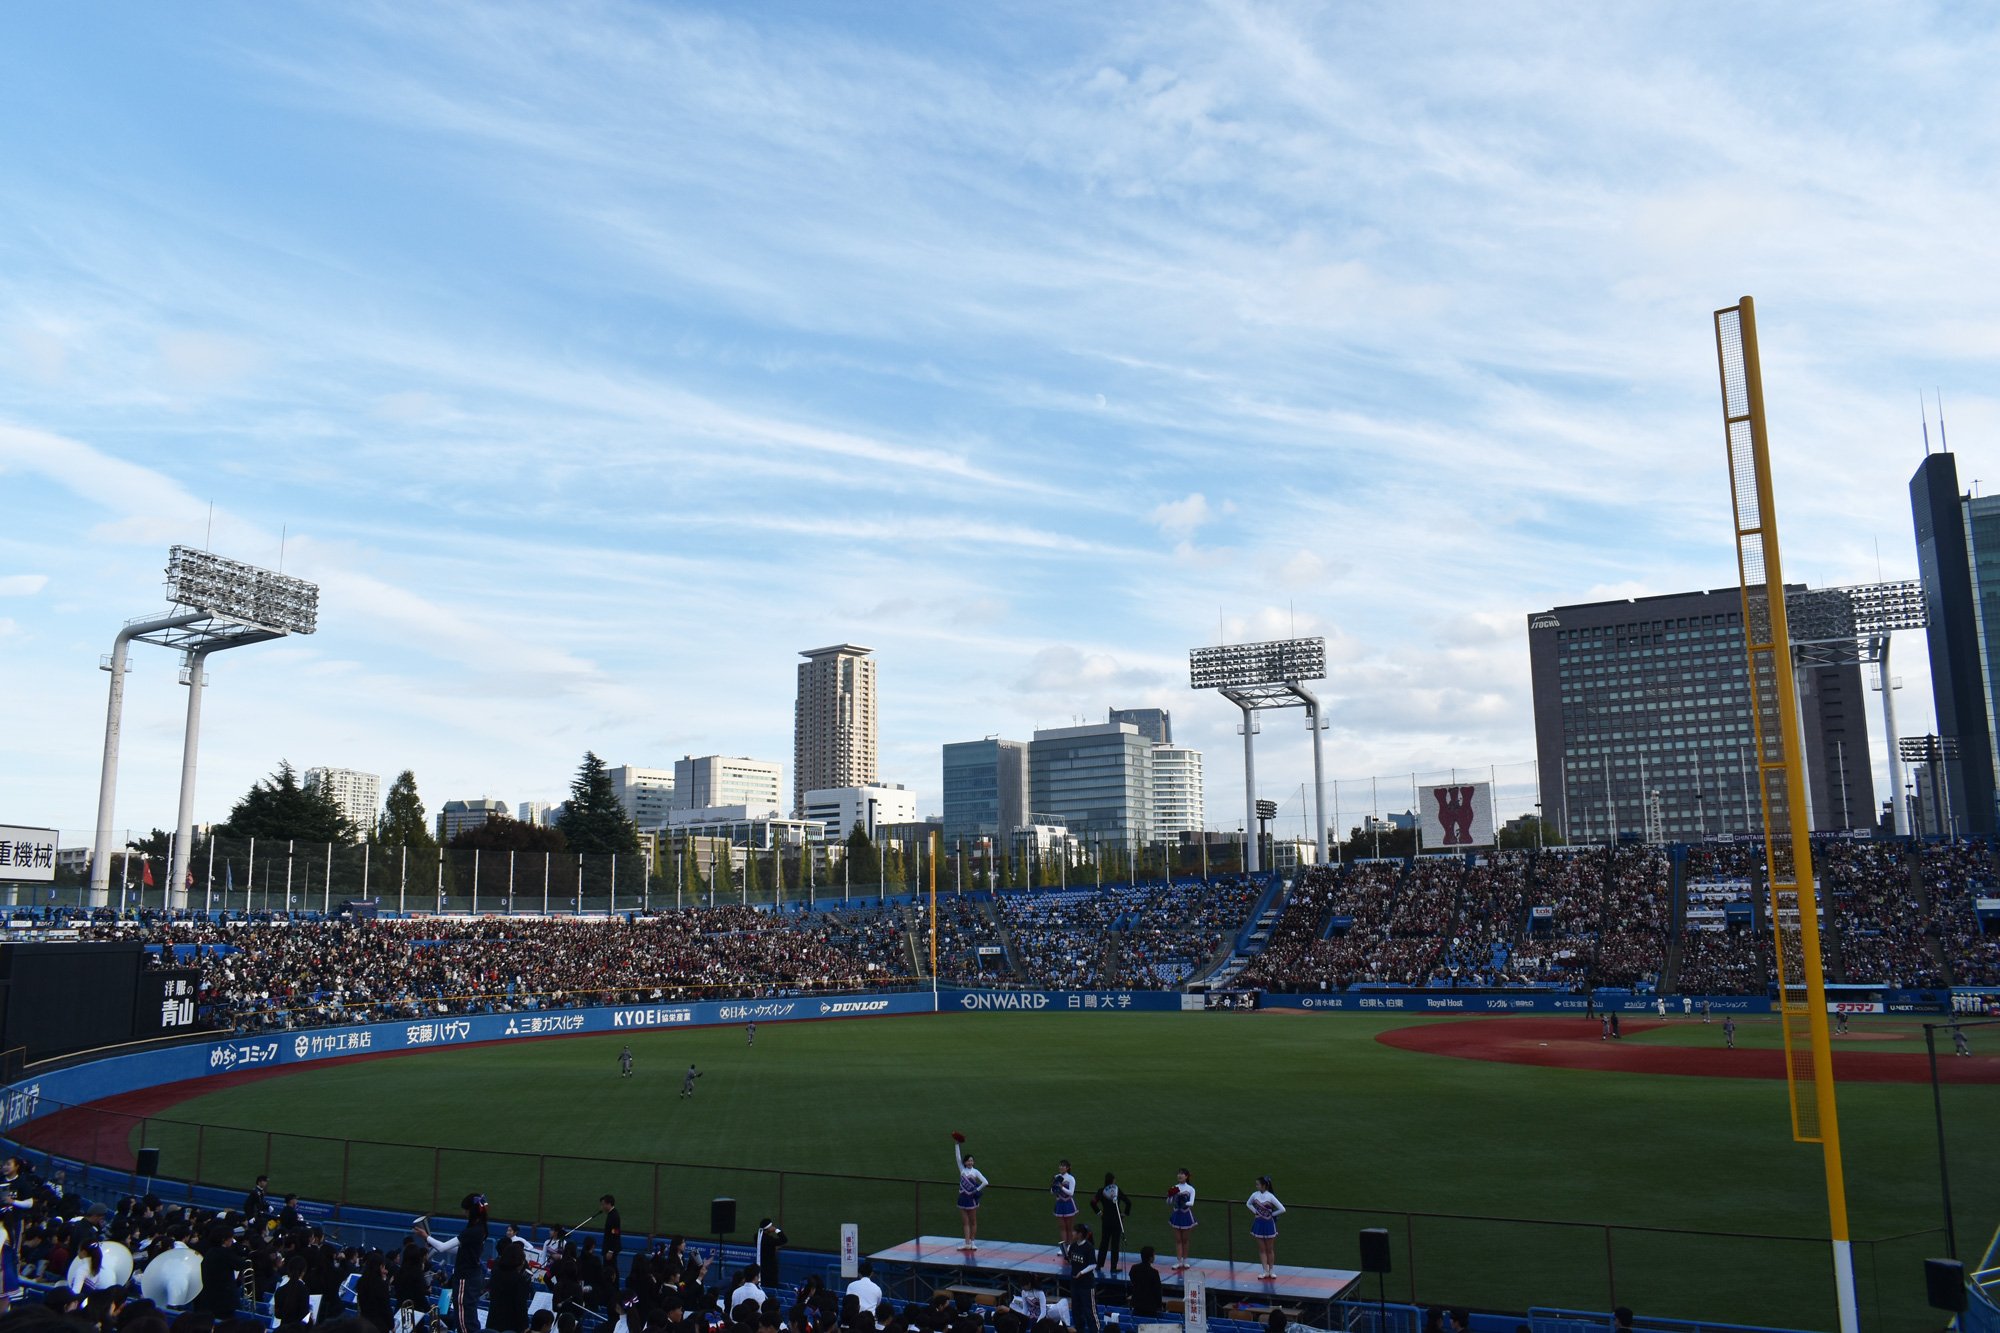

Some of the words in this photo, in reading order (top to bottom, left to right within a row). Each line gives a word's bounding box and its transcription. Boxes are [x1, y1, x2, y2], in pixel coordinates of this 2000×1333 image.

[1530, 620, 1560, 630] ITOCHU
[164, 980, 194, 997] 洋服の
[831, 1001, 888, 1012] DUNLOP
[960, 993, 1049, 1010] ONWARD
[1427, 998, 1446, 1008] Royal
[1447, 998, 1463, 1007] Host
[162, 998, 194, 1027] 青山
[614, 1009, 661, 1026] KYOEI
[730, 1003, 795, 1019] 日本ハウズイング
[406, 1020, 470, 1045] 安藤ハザマ
[520, 1015, 584, 1033] 三菱ガス化学
[311, 1031, 372, 1054] 竹中工務店
[210, 1043, 278, 1068] めちゃコミック
